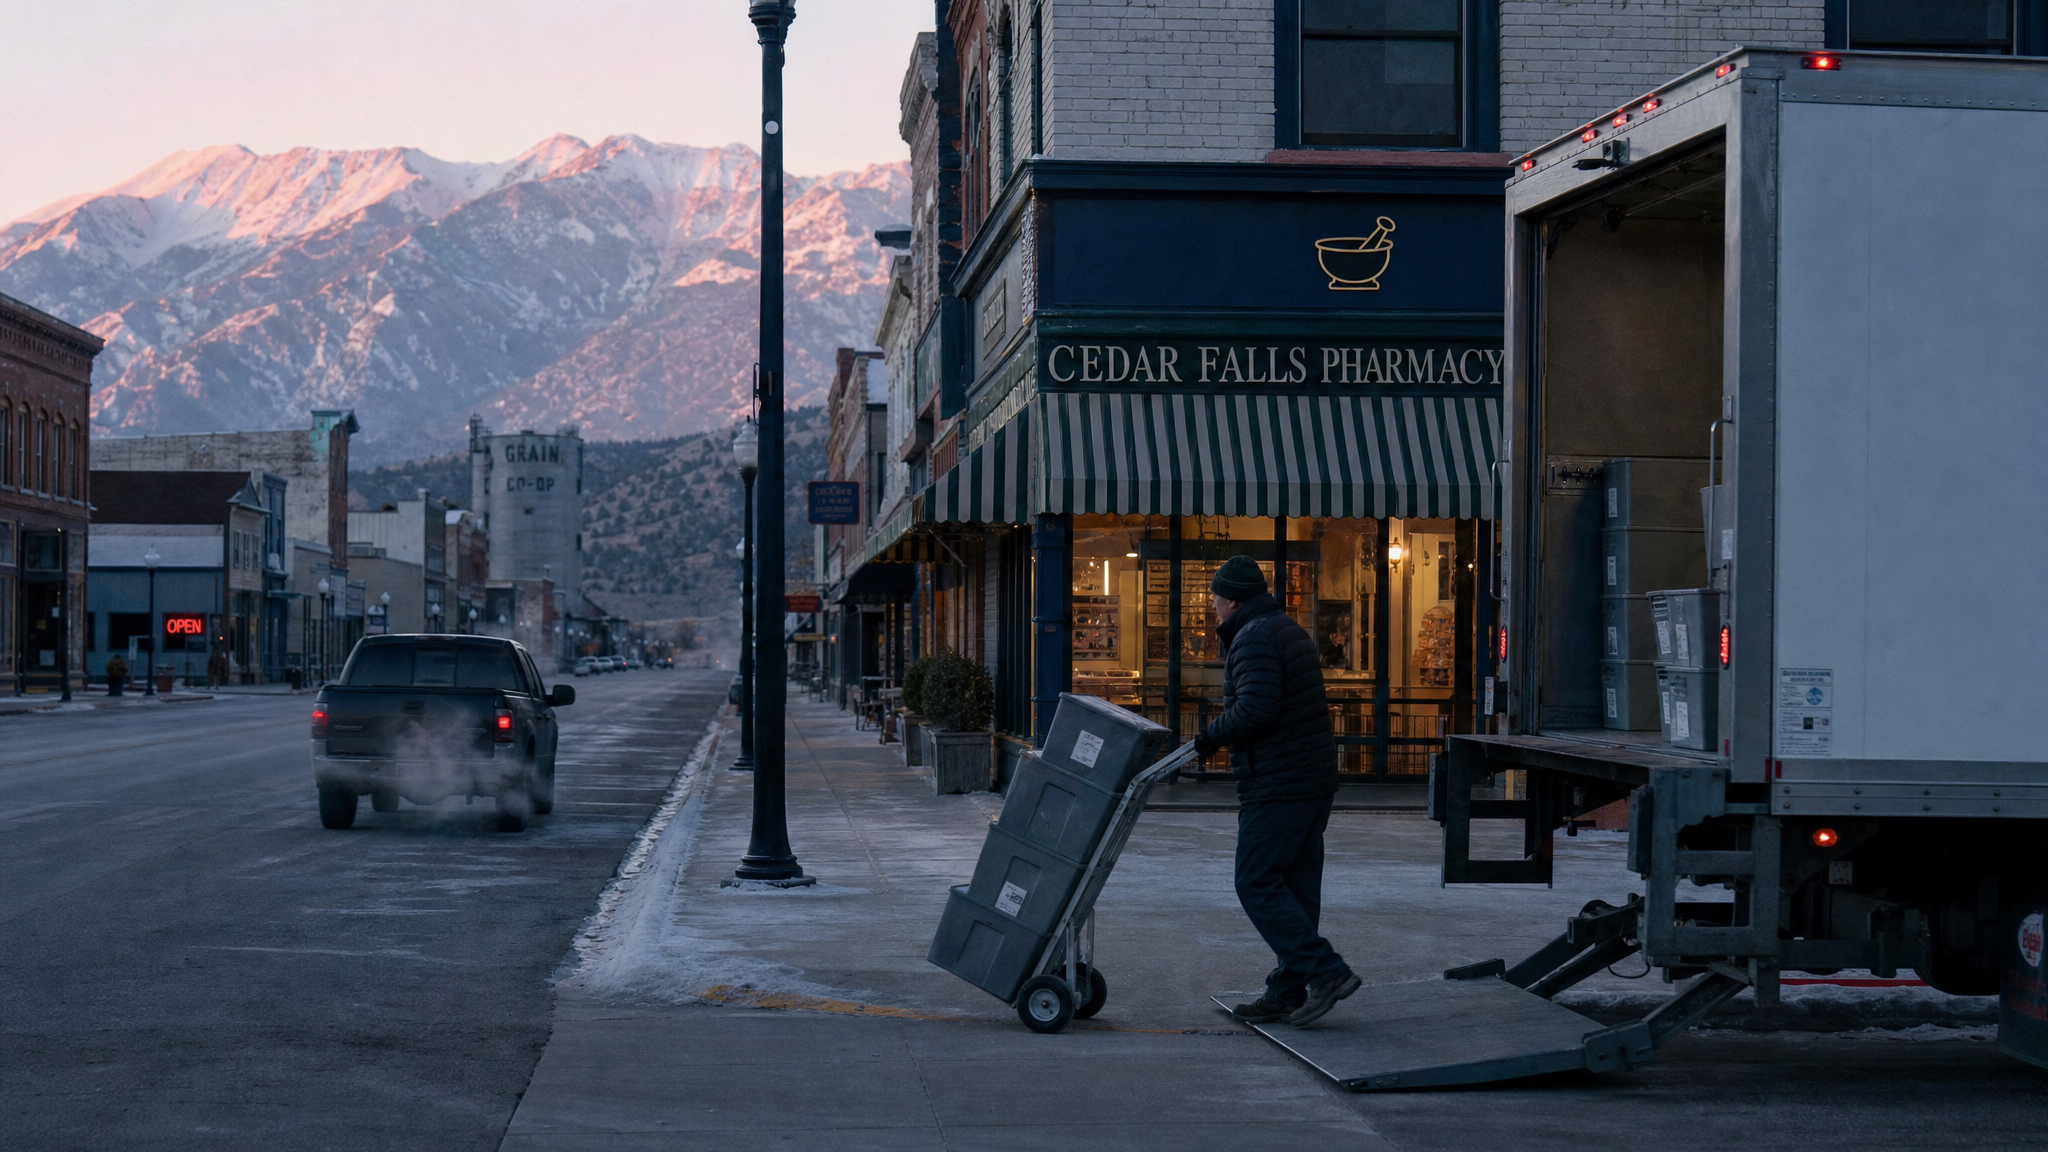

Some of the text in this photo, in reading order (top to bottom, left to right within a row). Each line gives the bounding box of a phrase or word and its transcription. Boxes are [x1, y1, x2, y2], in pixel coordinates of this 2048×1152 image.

[1048, 344, 1505, 385] CEDAR FALLS PHARMACY
[505, 444, 559, 463] GRAIN
[507, 476, 555, 492] CO-OP
[166, 618, 202, 634] OPEN
